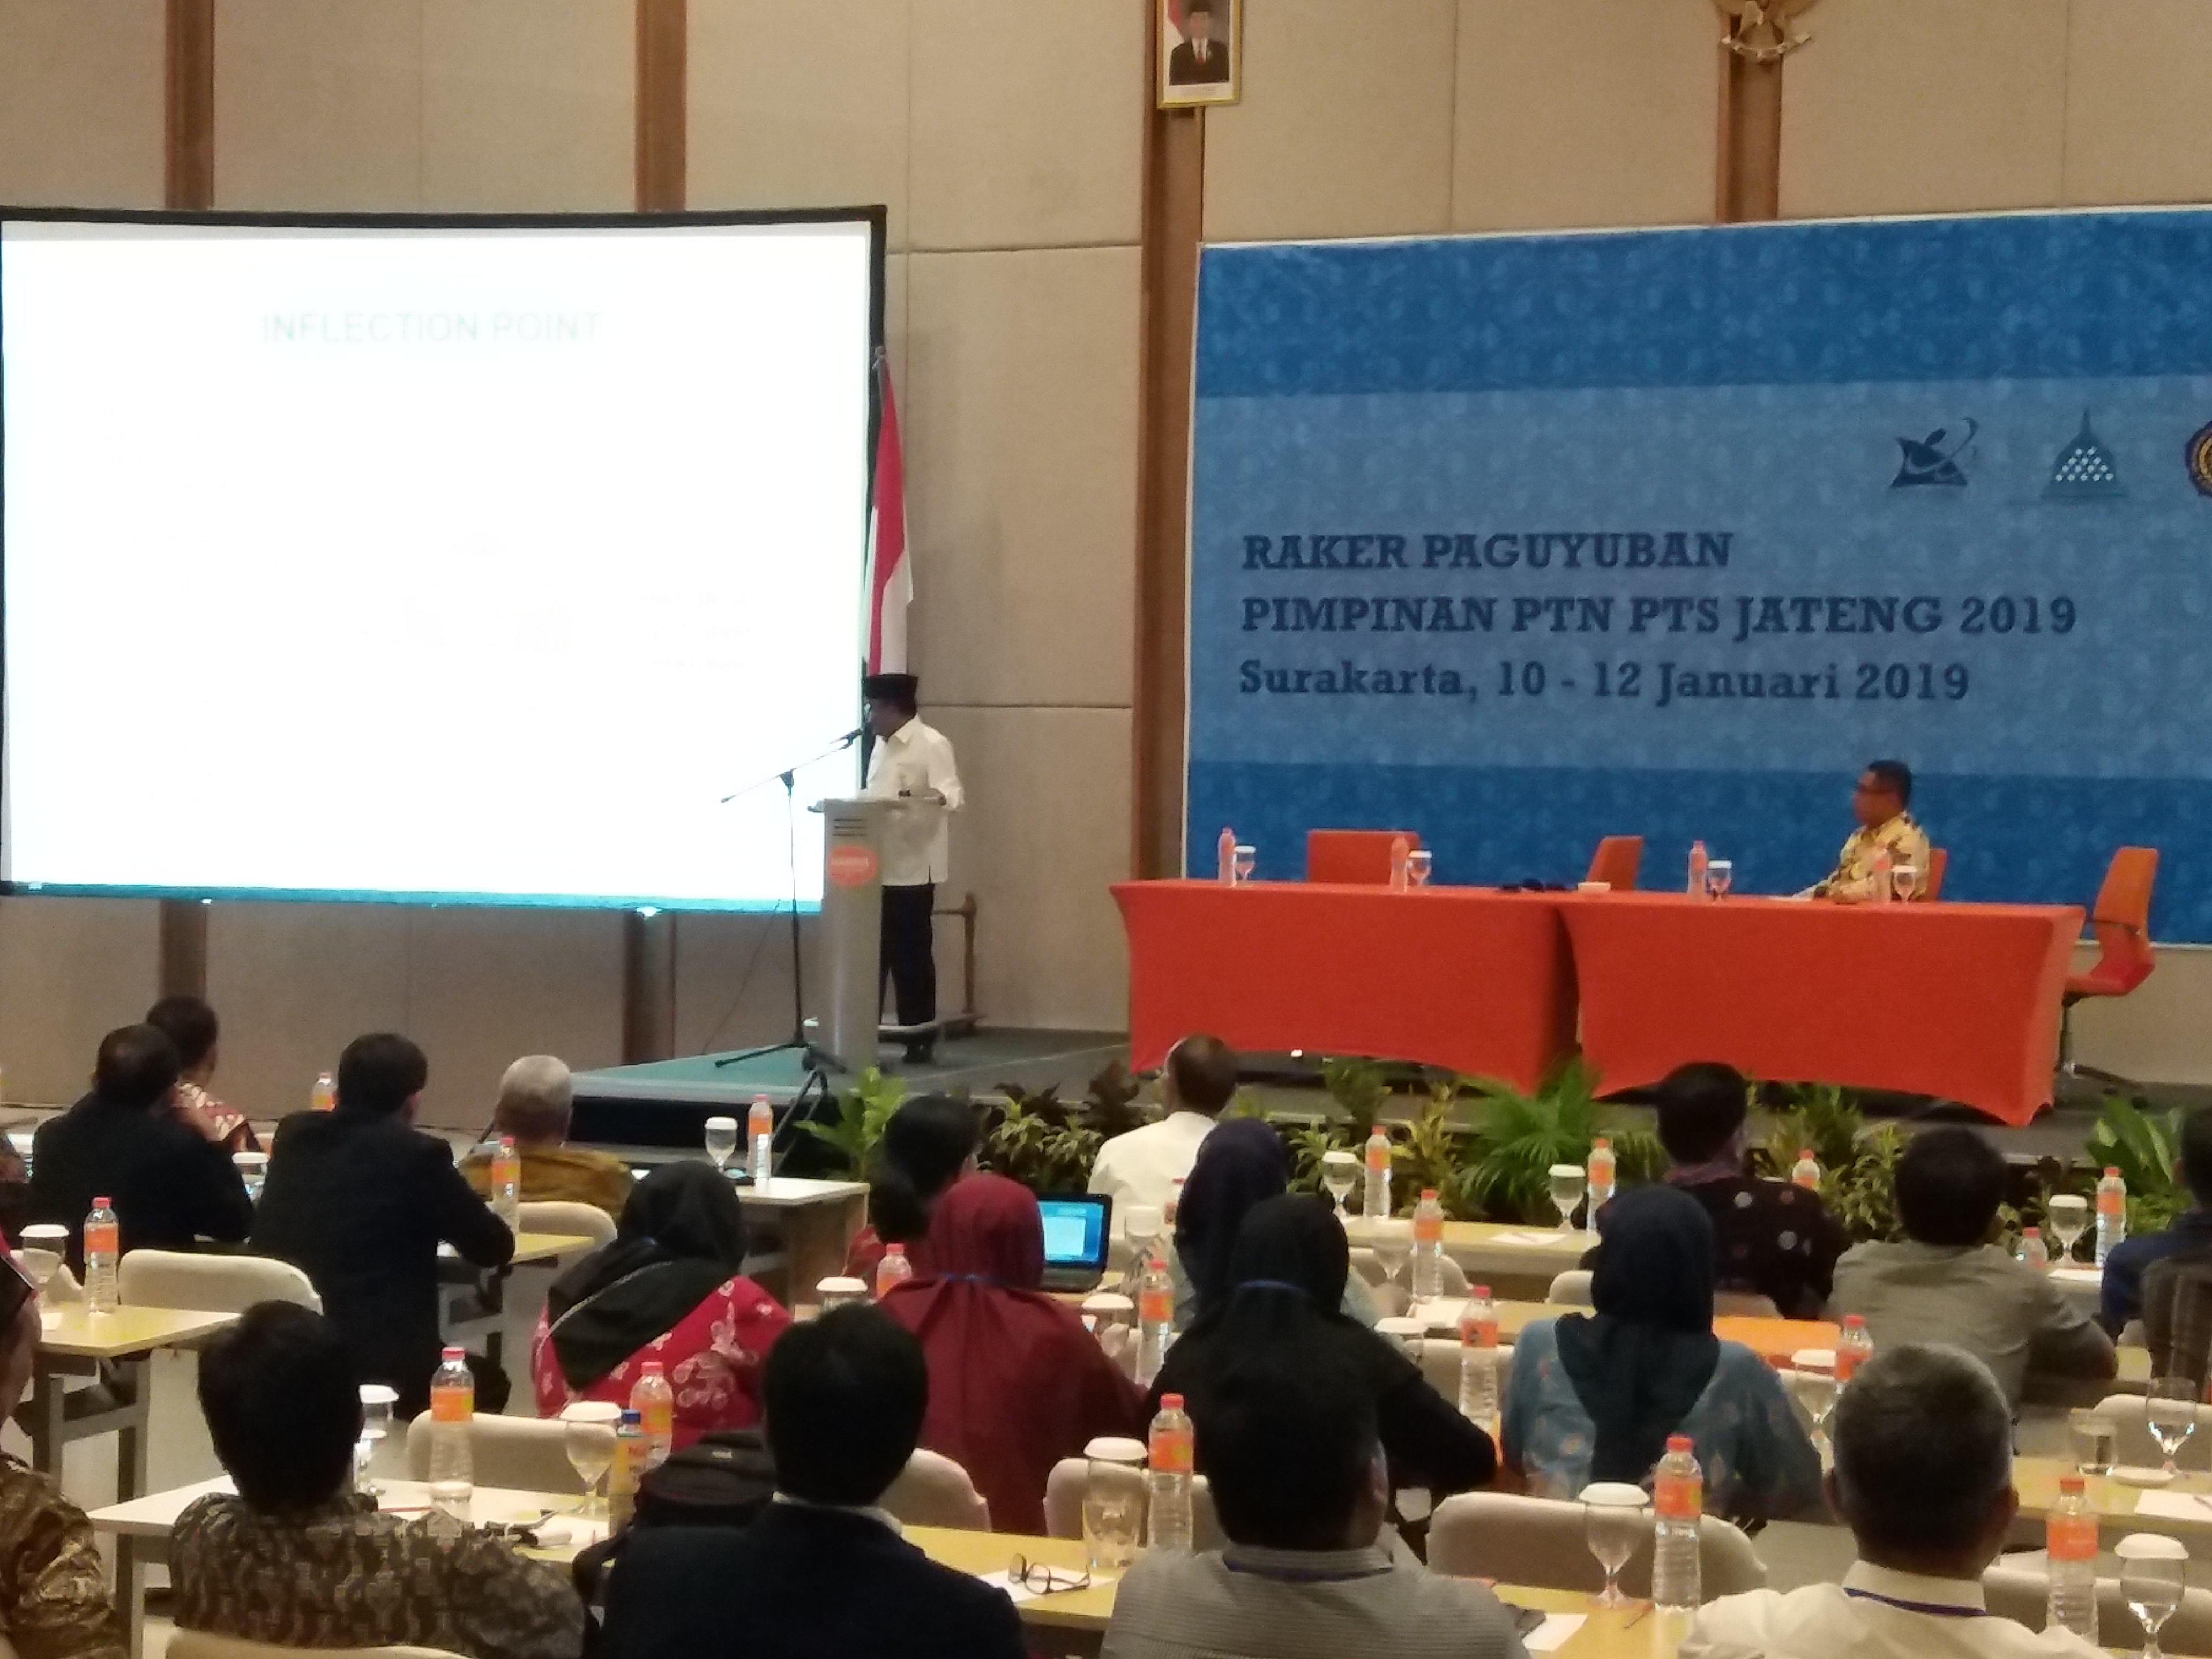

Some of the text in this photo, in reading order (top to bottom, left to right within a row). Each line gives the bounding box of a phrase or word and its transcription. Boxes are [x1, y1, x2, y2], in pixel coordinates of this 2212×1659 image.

[263, 312, 601, 342] INFLECTION POINT
[1243, 533, 1733, 569] RAKER PAGUYUBAN
[1242, 596, 2076, 642] PIMPINAN PTN PTS JATENG 2019
[1240, 660, 1477, 703] Surakarta,
[1499, 661, 1545, 697] 10
[1594, 661, 1641, 697] 12
[1655, 662, 1840, 708] Januari
[1856, 663, 1969, 700] 2019
